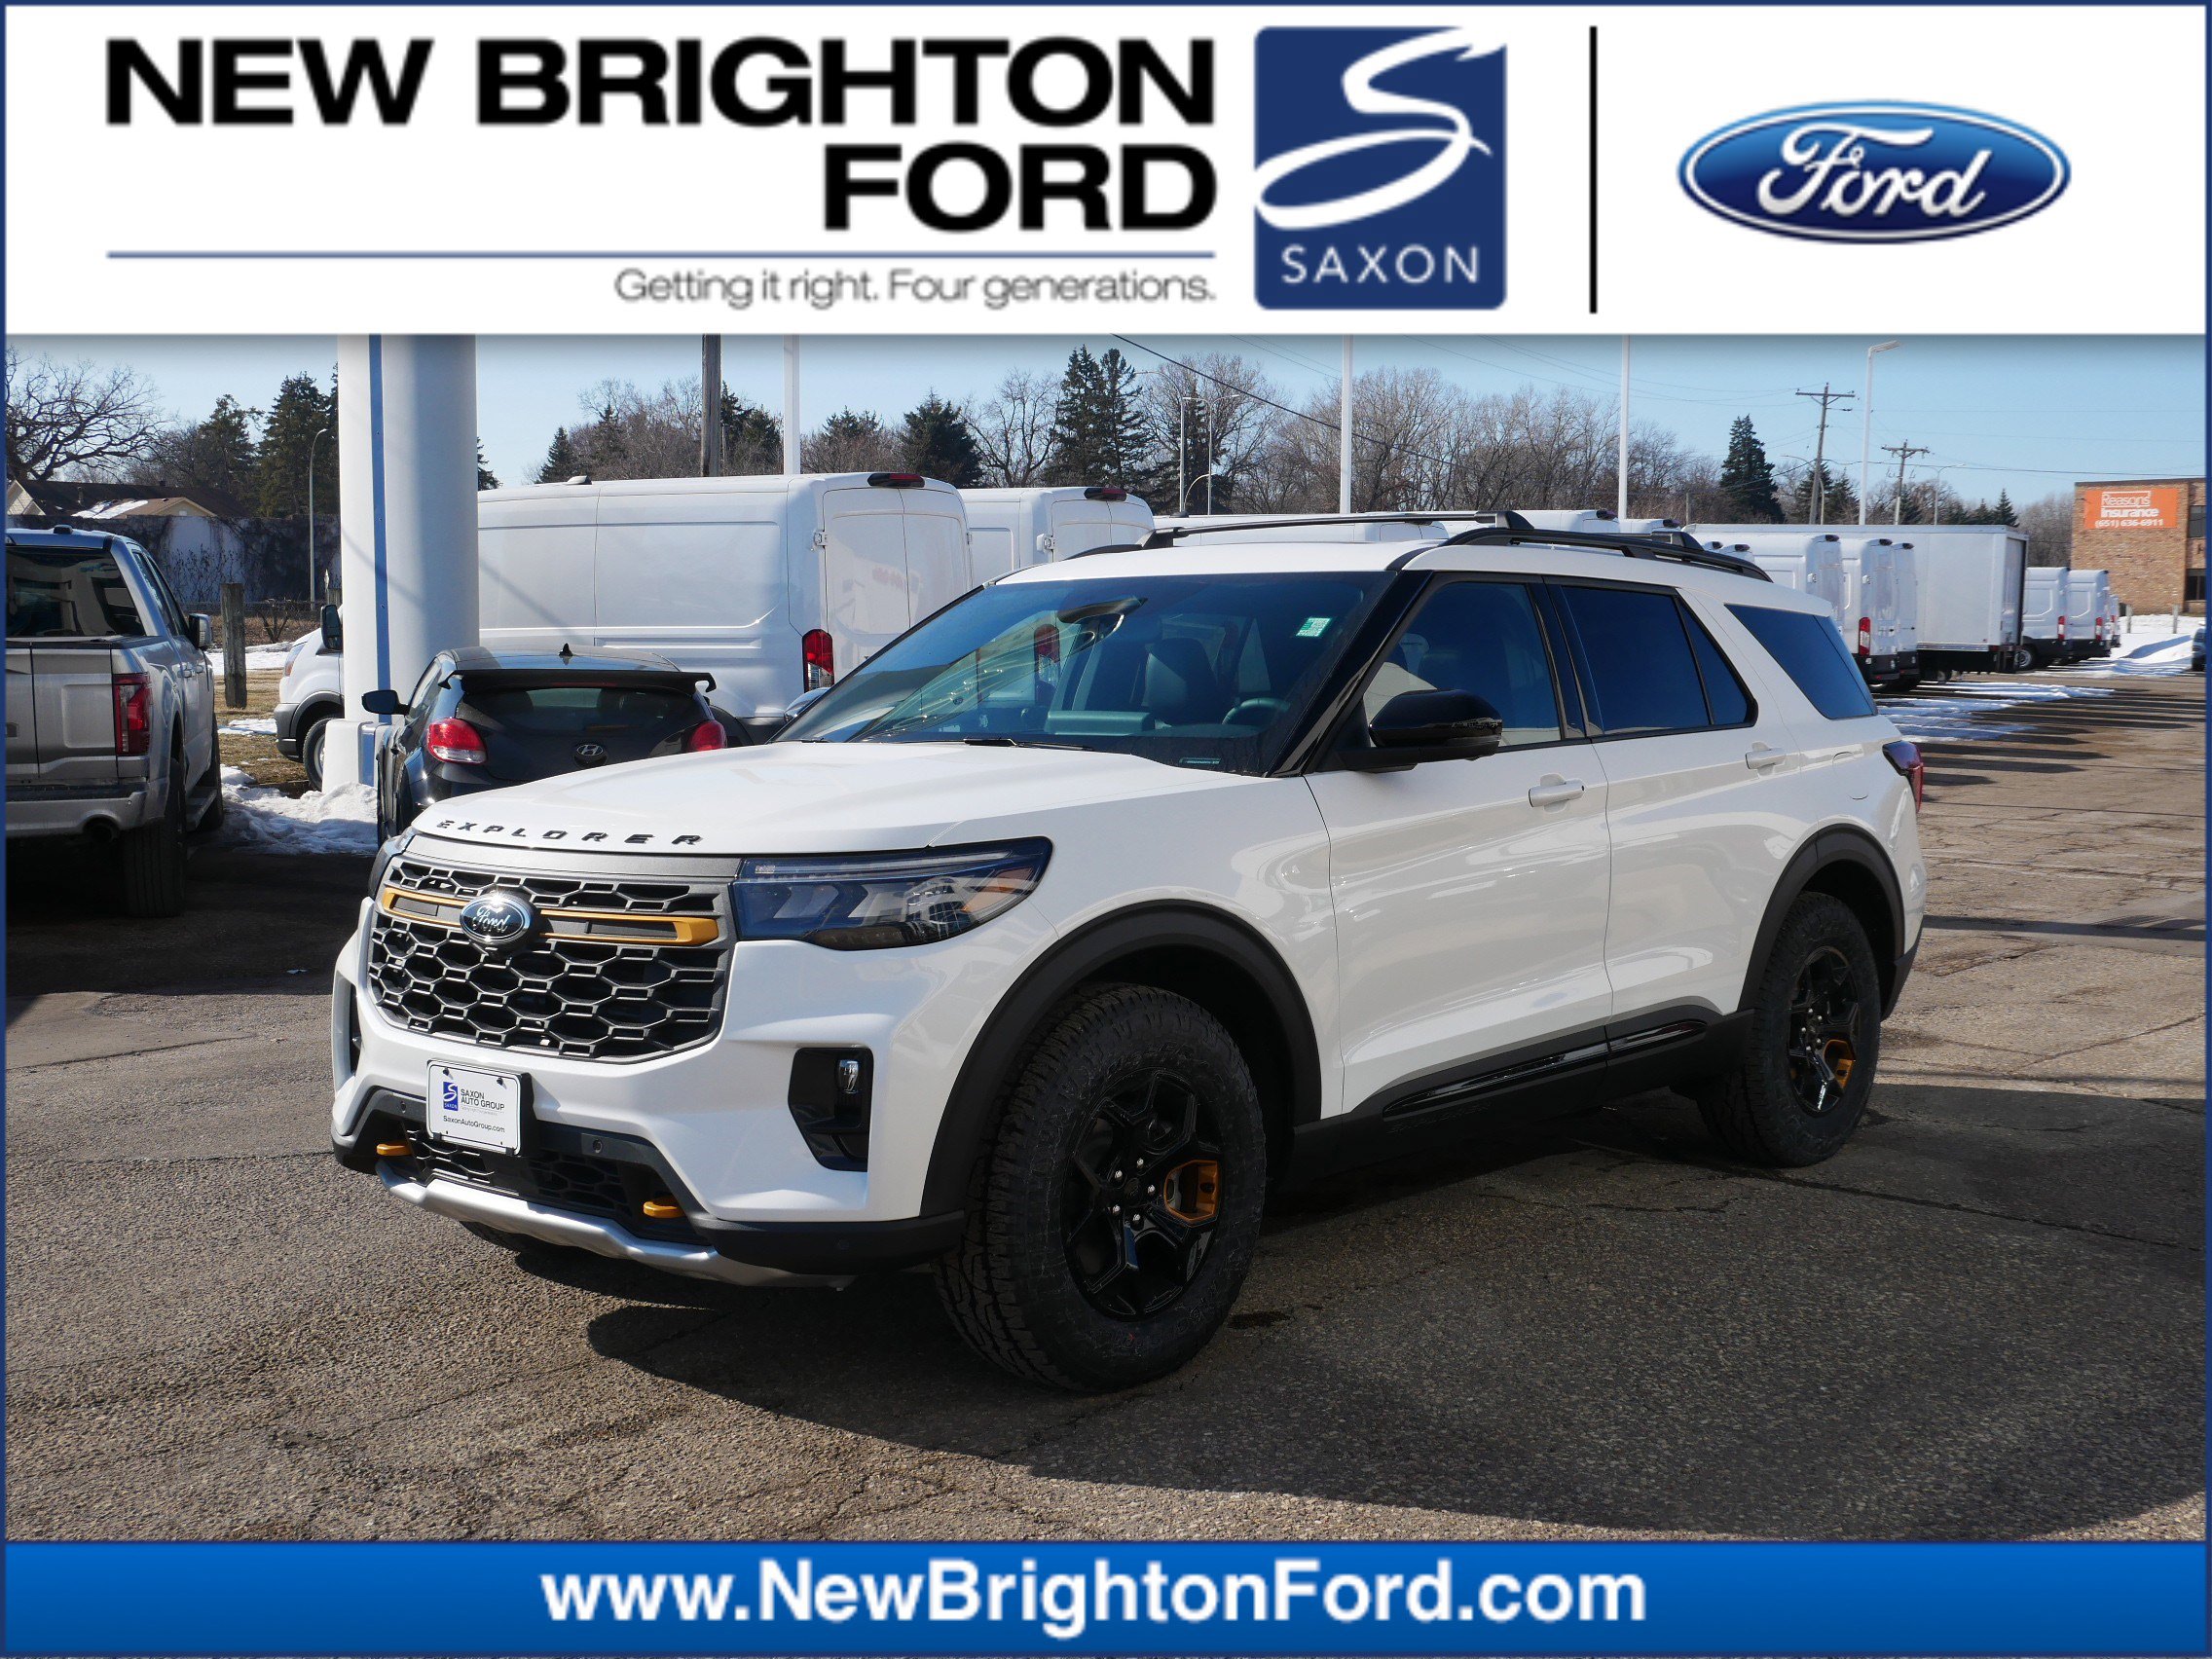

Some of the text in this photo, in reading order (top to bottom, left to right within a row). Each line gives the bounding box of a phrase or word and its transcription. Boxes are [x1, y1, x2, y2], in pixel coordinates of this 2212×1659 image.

[2100, 507, 2160, 518] Insurance
[436, 821, 703, 845] EXPLORER
[472, 904, 511, 934] Ford
[461, 1088, 484, 1099] SAXON
[461, 1097, 504, 1110] AUTO GROUP
[443, 1115, 505, 1133] SaxonAutoGroup.com
